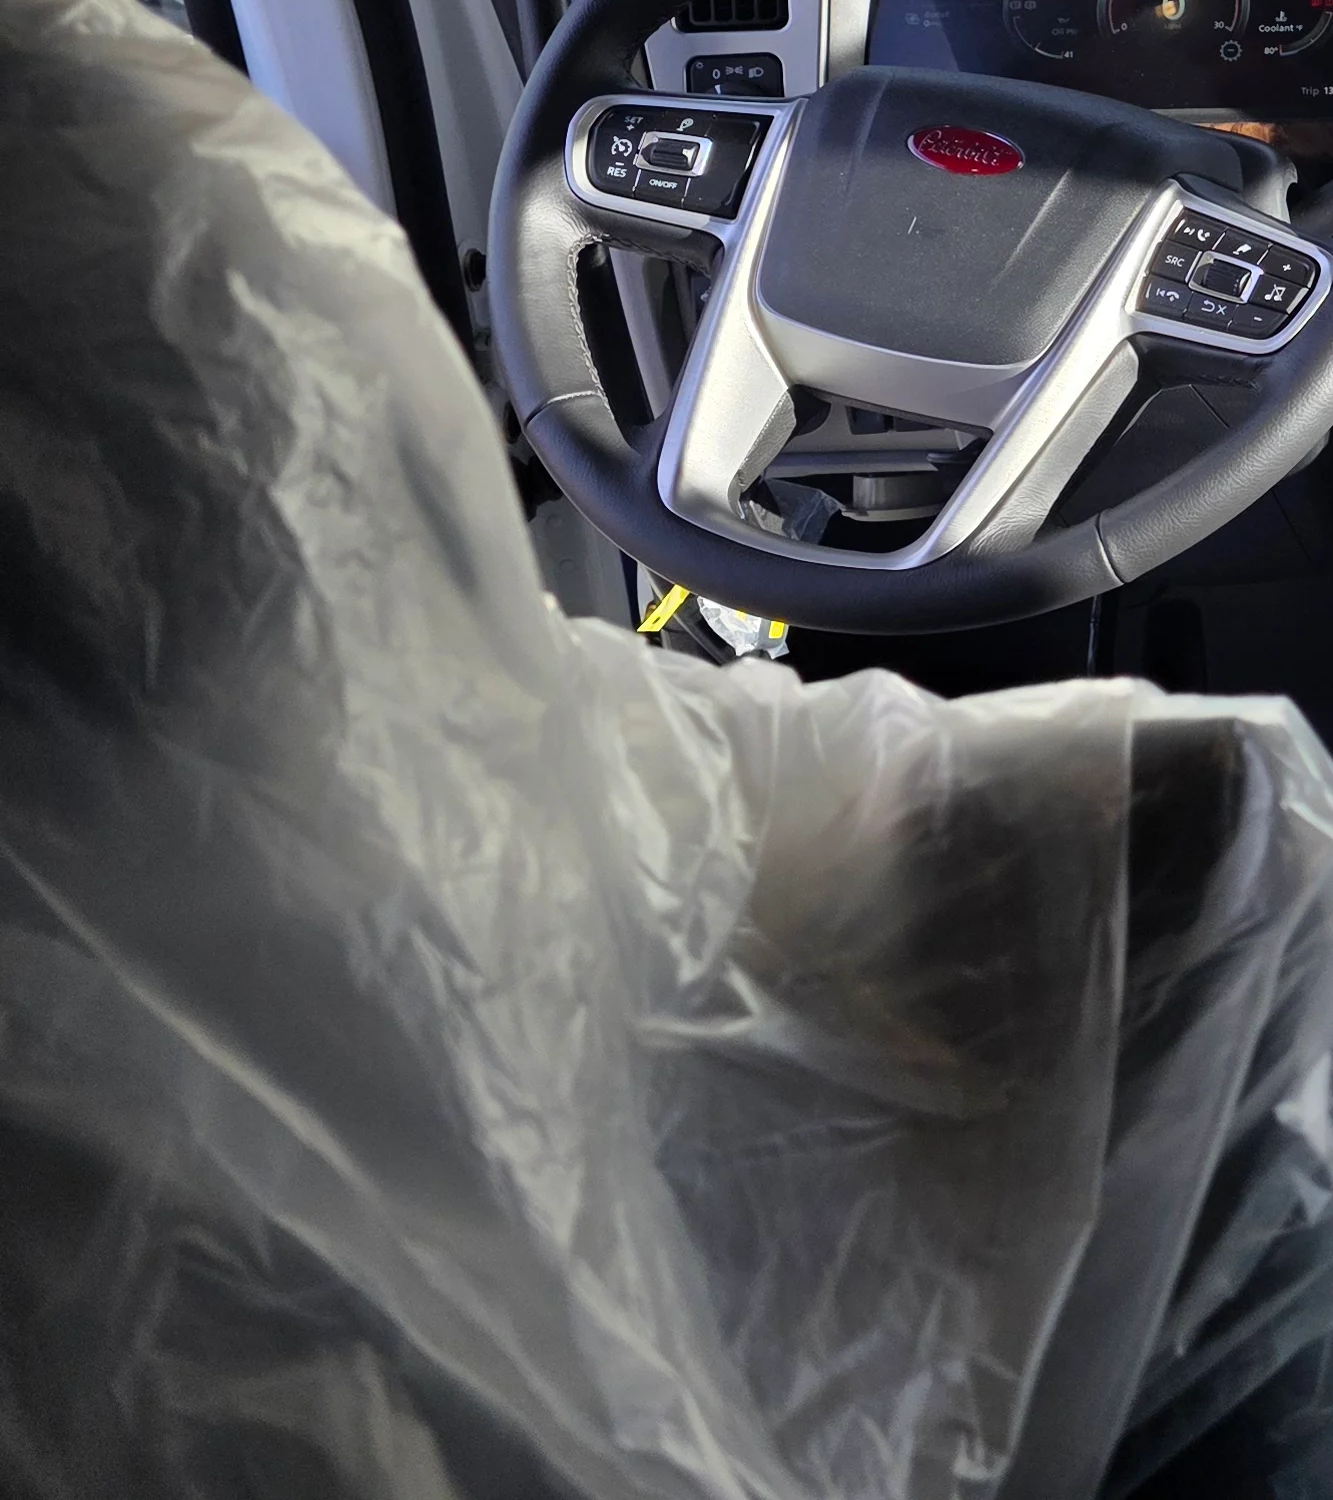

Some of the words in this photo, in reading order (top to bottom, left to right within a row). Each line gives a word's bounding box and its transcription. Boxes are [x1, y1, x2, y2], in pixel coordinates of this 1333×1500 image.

[1121, 23, 1128, 31] 0
[1213, 21, 1225, 30] 30
[1258, 23, 1294, 33] Coolant
[1300, 86, 1320, 97] Trip
[624, 115, 644, 125] SET
[607, 167, 627, 179] RES
[649, 178, 678, 190] ON/OFF
[1165, 254, 1185, 268] SRC
